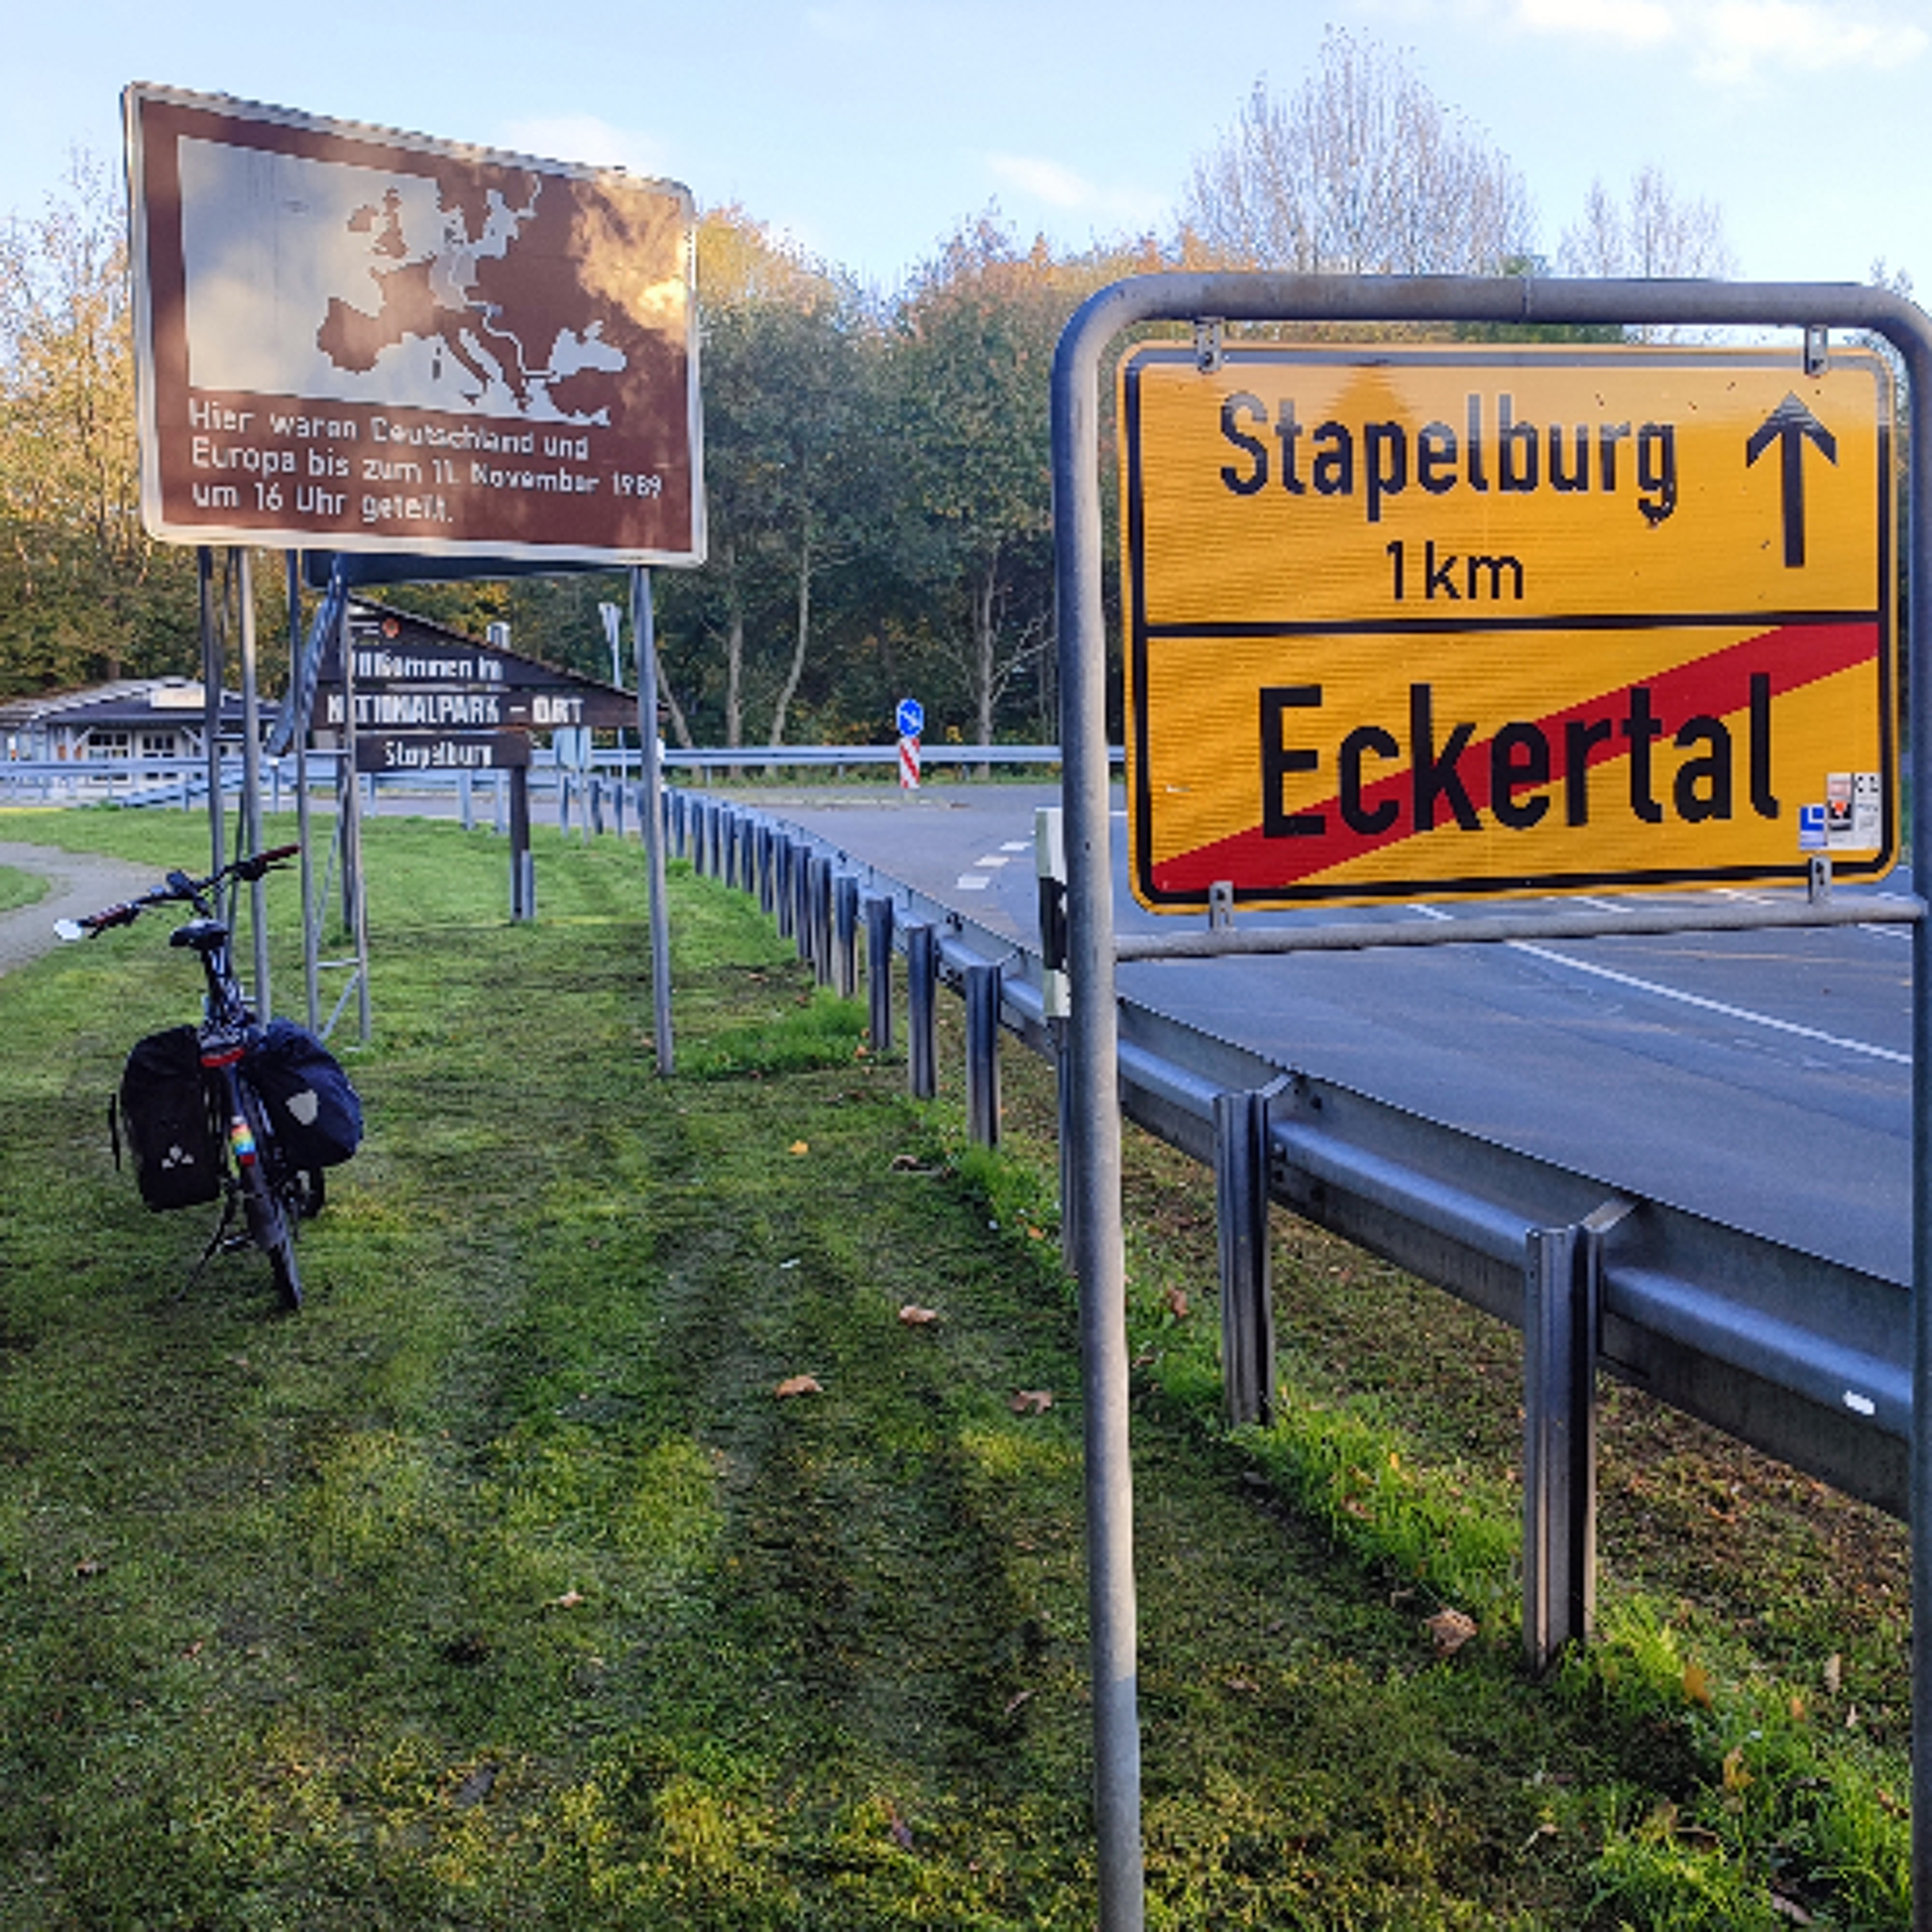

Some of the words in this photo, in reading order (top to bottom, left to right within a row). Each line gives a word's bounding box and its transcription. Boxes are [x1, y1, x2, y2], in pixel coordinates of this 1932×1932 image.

[189, 397, 254, 433] Hier
[270, 411, 358, 440] waren
[370, 417, 534, 453] Deutschland
[544, 435, 589, 460] und
[1219, 390, 1676, 526] Stapelburg
[192, 435, 296, 479] Europa
[308, 446, 350, 477] bis
[362, 458, 422, 484] zum
[470, 459, 600, 494] November
[612, 471, 663, 500] 1989
[192, 481, 240, 509] um
[254, 482, 283, 512] 16
[296, 484, 348, 515] Uhr
[327, 694, 500, 724] NTIONALPARK
[1258, 672, 1780, 838] Eckertal
